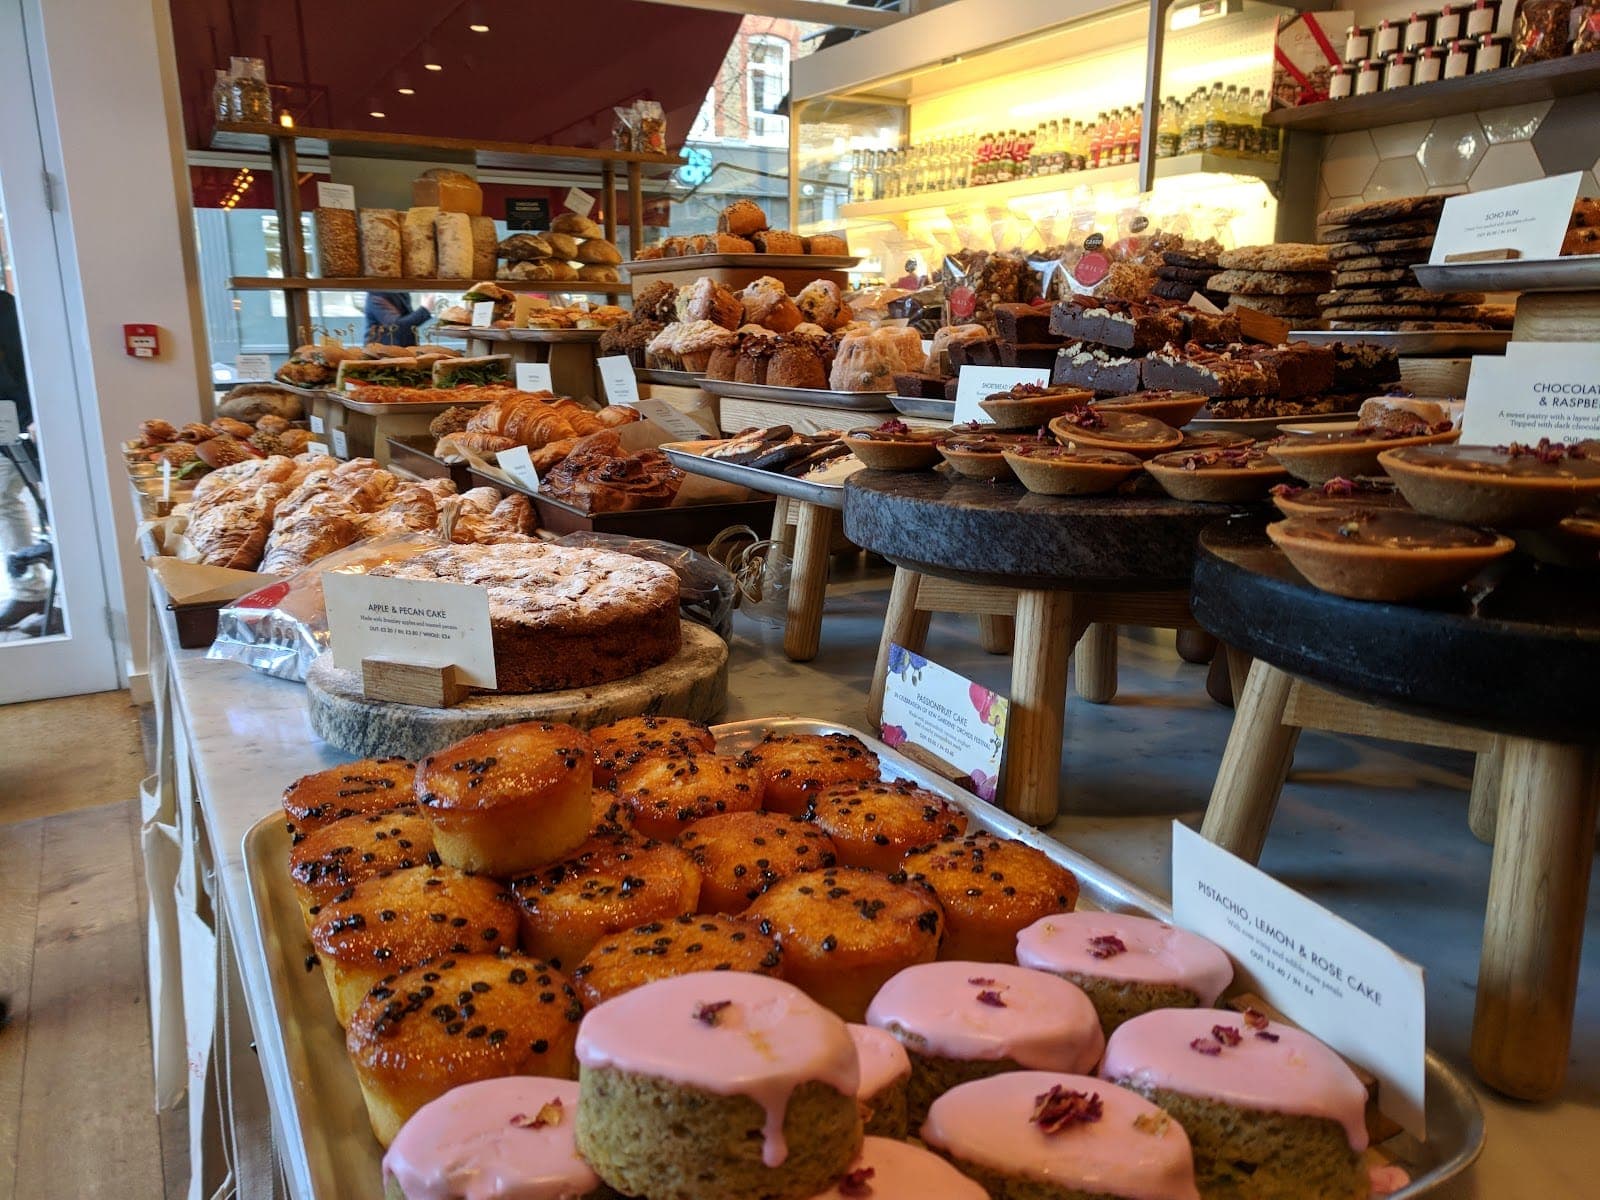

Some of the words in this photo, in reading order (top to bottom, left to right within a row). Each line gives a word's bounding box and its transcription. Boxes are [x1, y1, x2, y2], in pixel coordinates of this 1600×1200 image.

[1505, 209, 1519, 217] BUN
[1539, 397, 1548, 406] &
[1552, 397, 1600, 409] RASPBE
[1526, 412, 1548, 420] pastry
[1572, 413, 1590, 422] layer
[1511, 420, 1536, 428] Topped
[1554, 421, 1570, 429] dark
[368, 603, 389, 613] APPLE
[391, 606, 397, 614] &
[399, 606, 425, 616] PECAN
[426, 609, 447, 619] CAKE
[917, 694, 952, 717] PASSIONFRUIT
[953, 713, 968, 726] CAKE
[928, 710, 936, 719] KEW
[1272, 947, 1284, 961] and
[1255, 916, 1295, 951] LEMON
[1299, 944, 1307, 959] &
[1311, 951, 1342, 981] ROSE
[1347, 976, 1381, 1006] CAKE
